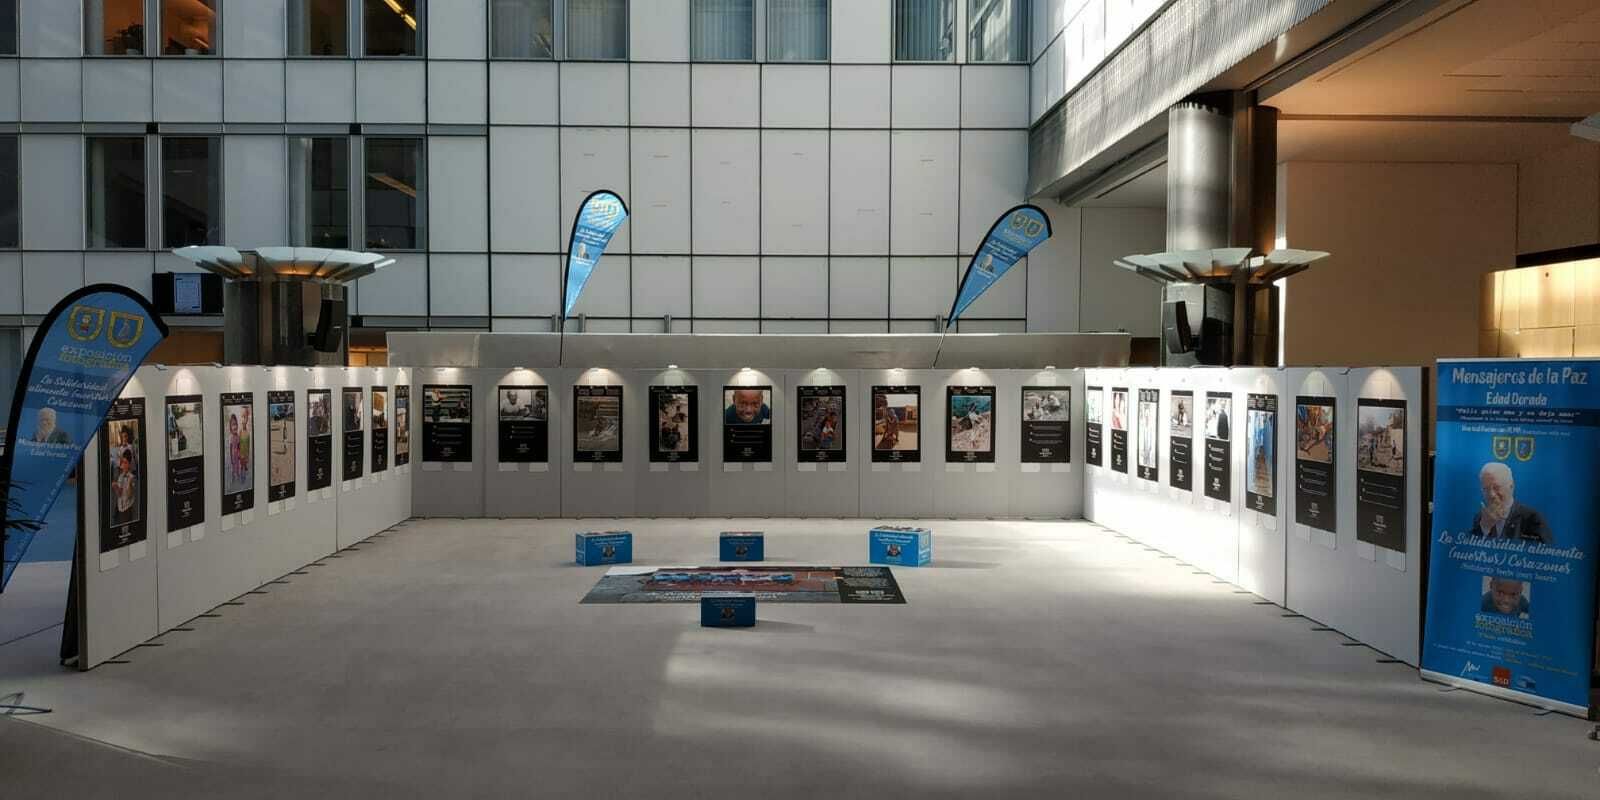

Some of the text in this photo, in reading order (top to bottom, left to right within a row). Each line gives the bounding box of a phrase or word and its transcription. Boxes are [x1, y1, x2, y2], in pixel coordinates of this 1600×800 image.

[1453, 366, 1588, 388] Mensajeros de la Paz
[1486, 391, 1548, 406] Edad Dorada
[1437, 530, 1585, 561] La Solidaridad alimenta
[1448, 546, 1571, 575] (nuestros) Corazones
